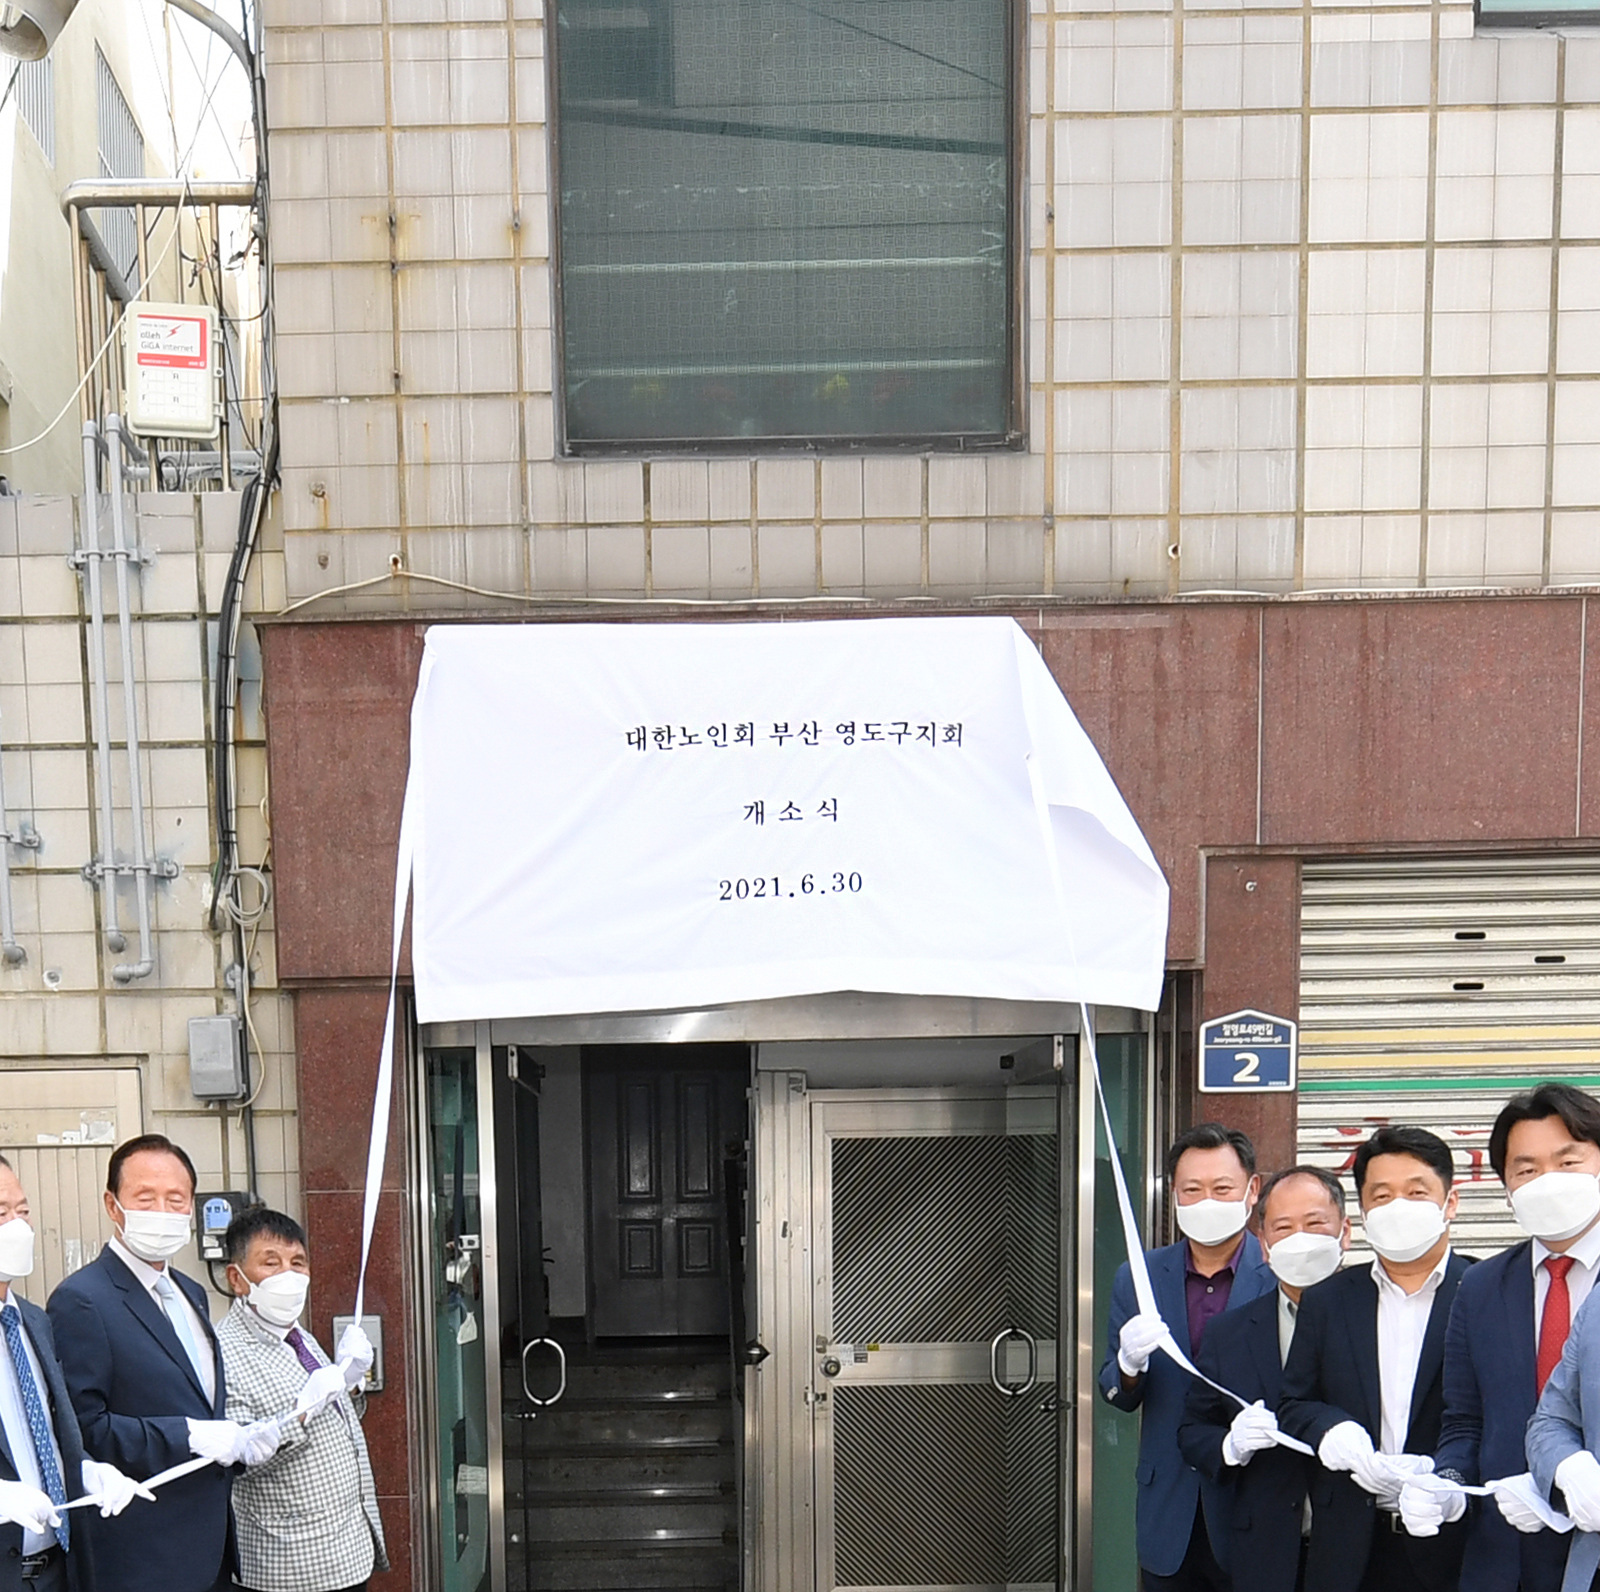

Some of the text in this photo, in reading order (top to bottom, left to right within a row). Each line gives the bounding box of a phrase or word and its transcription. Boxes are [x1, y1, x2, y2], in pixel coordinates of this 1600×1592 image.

[140, 331, 160, 339] olleh
[162, 343, 194, 352] internet
[625, 720, 964, 752] 대한노인회 부산 영도구지회
[719, 871, 863, 901] 2021.6.30
[1233, 1052, 1260, 1082] 2
